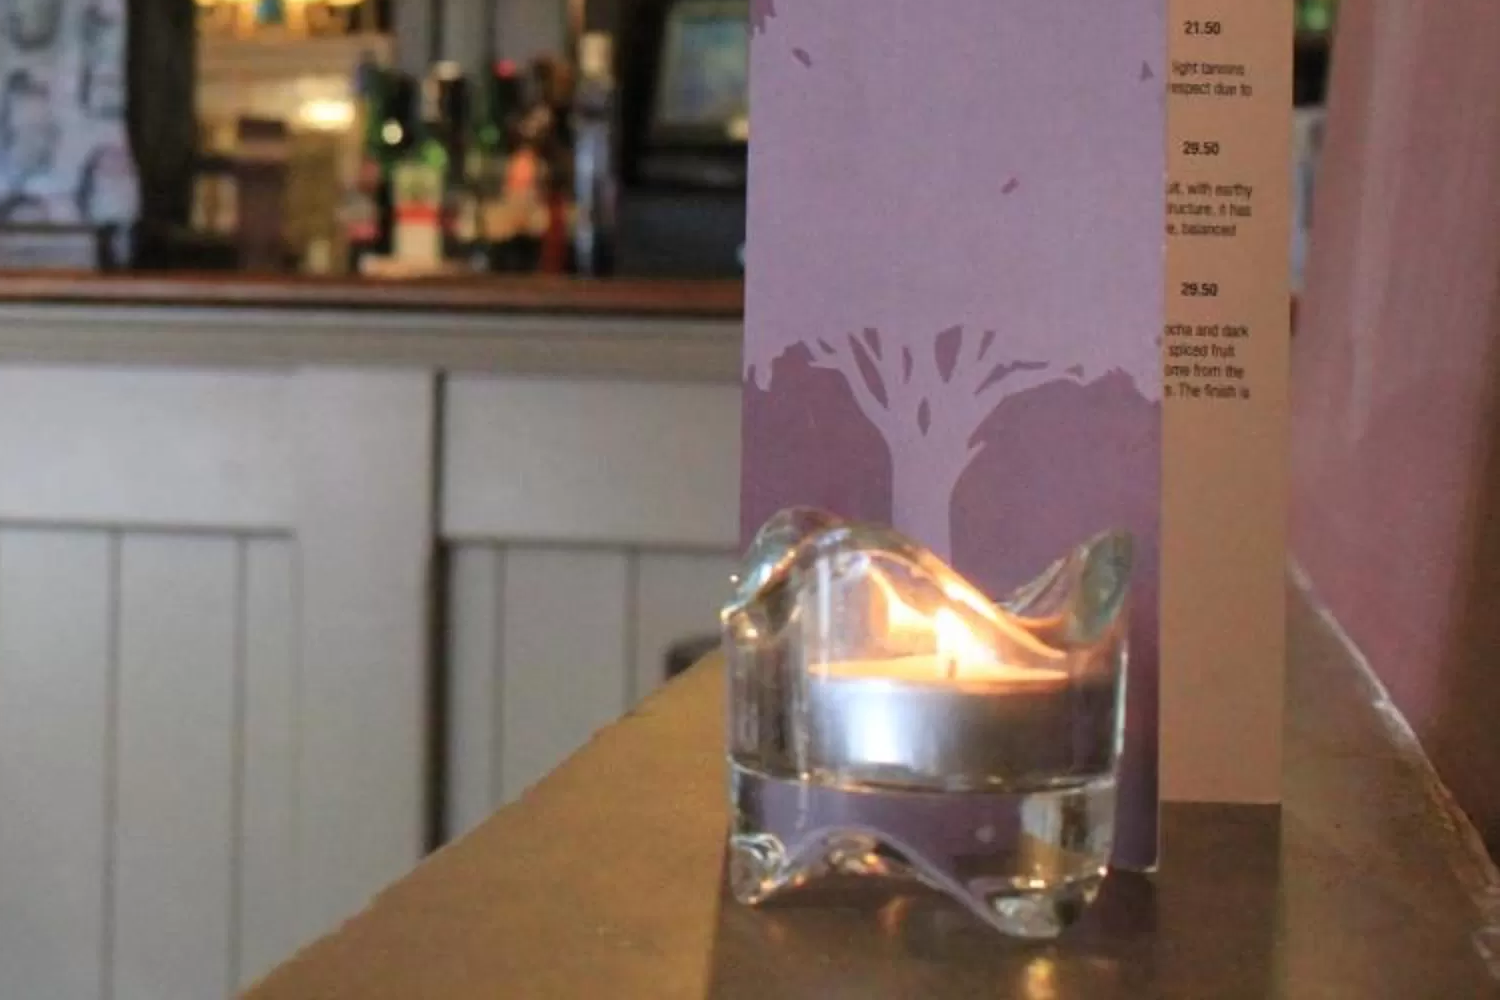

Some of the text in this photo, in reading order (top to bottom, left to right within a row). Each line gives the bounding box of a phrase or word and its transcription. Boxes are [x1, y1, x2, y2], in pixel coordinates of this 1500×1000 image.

[1183, 20, 1221, 35] 21.50
[1182, 141, 1220, 156] 29.50
[1180, 282, 1218, 297] 29.50
[1195, 325, 1219, 338] and
[1193, 364, 1221, 377] from
[1226, 365, 1246, 379] the
[1178, 383, 1201, 398] The
